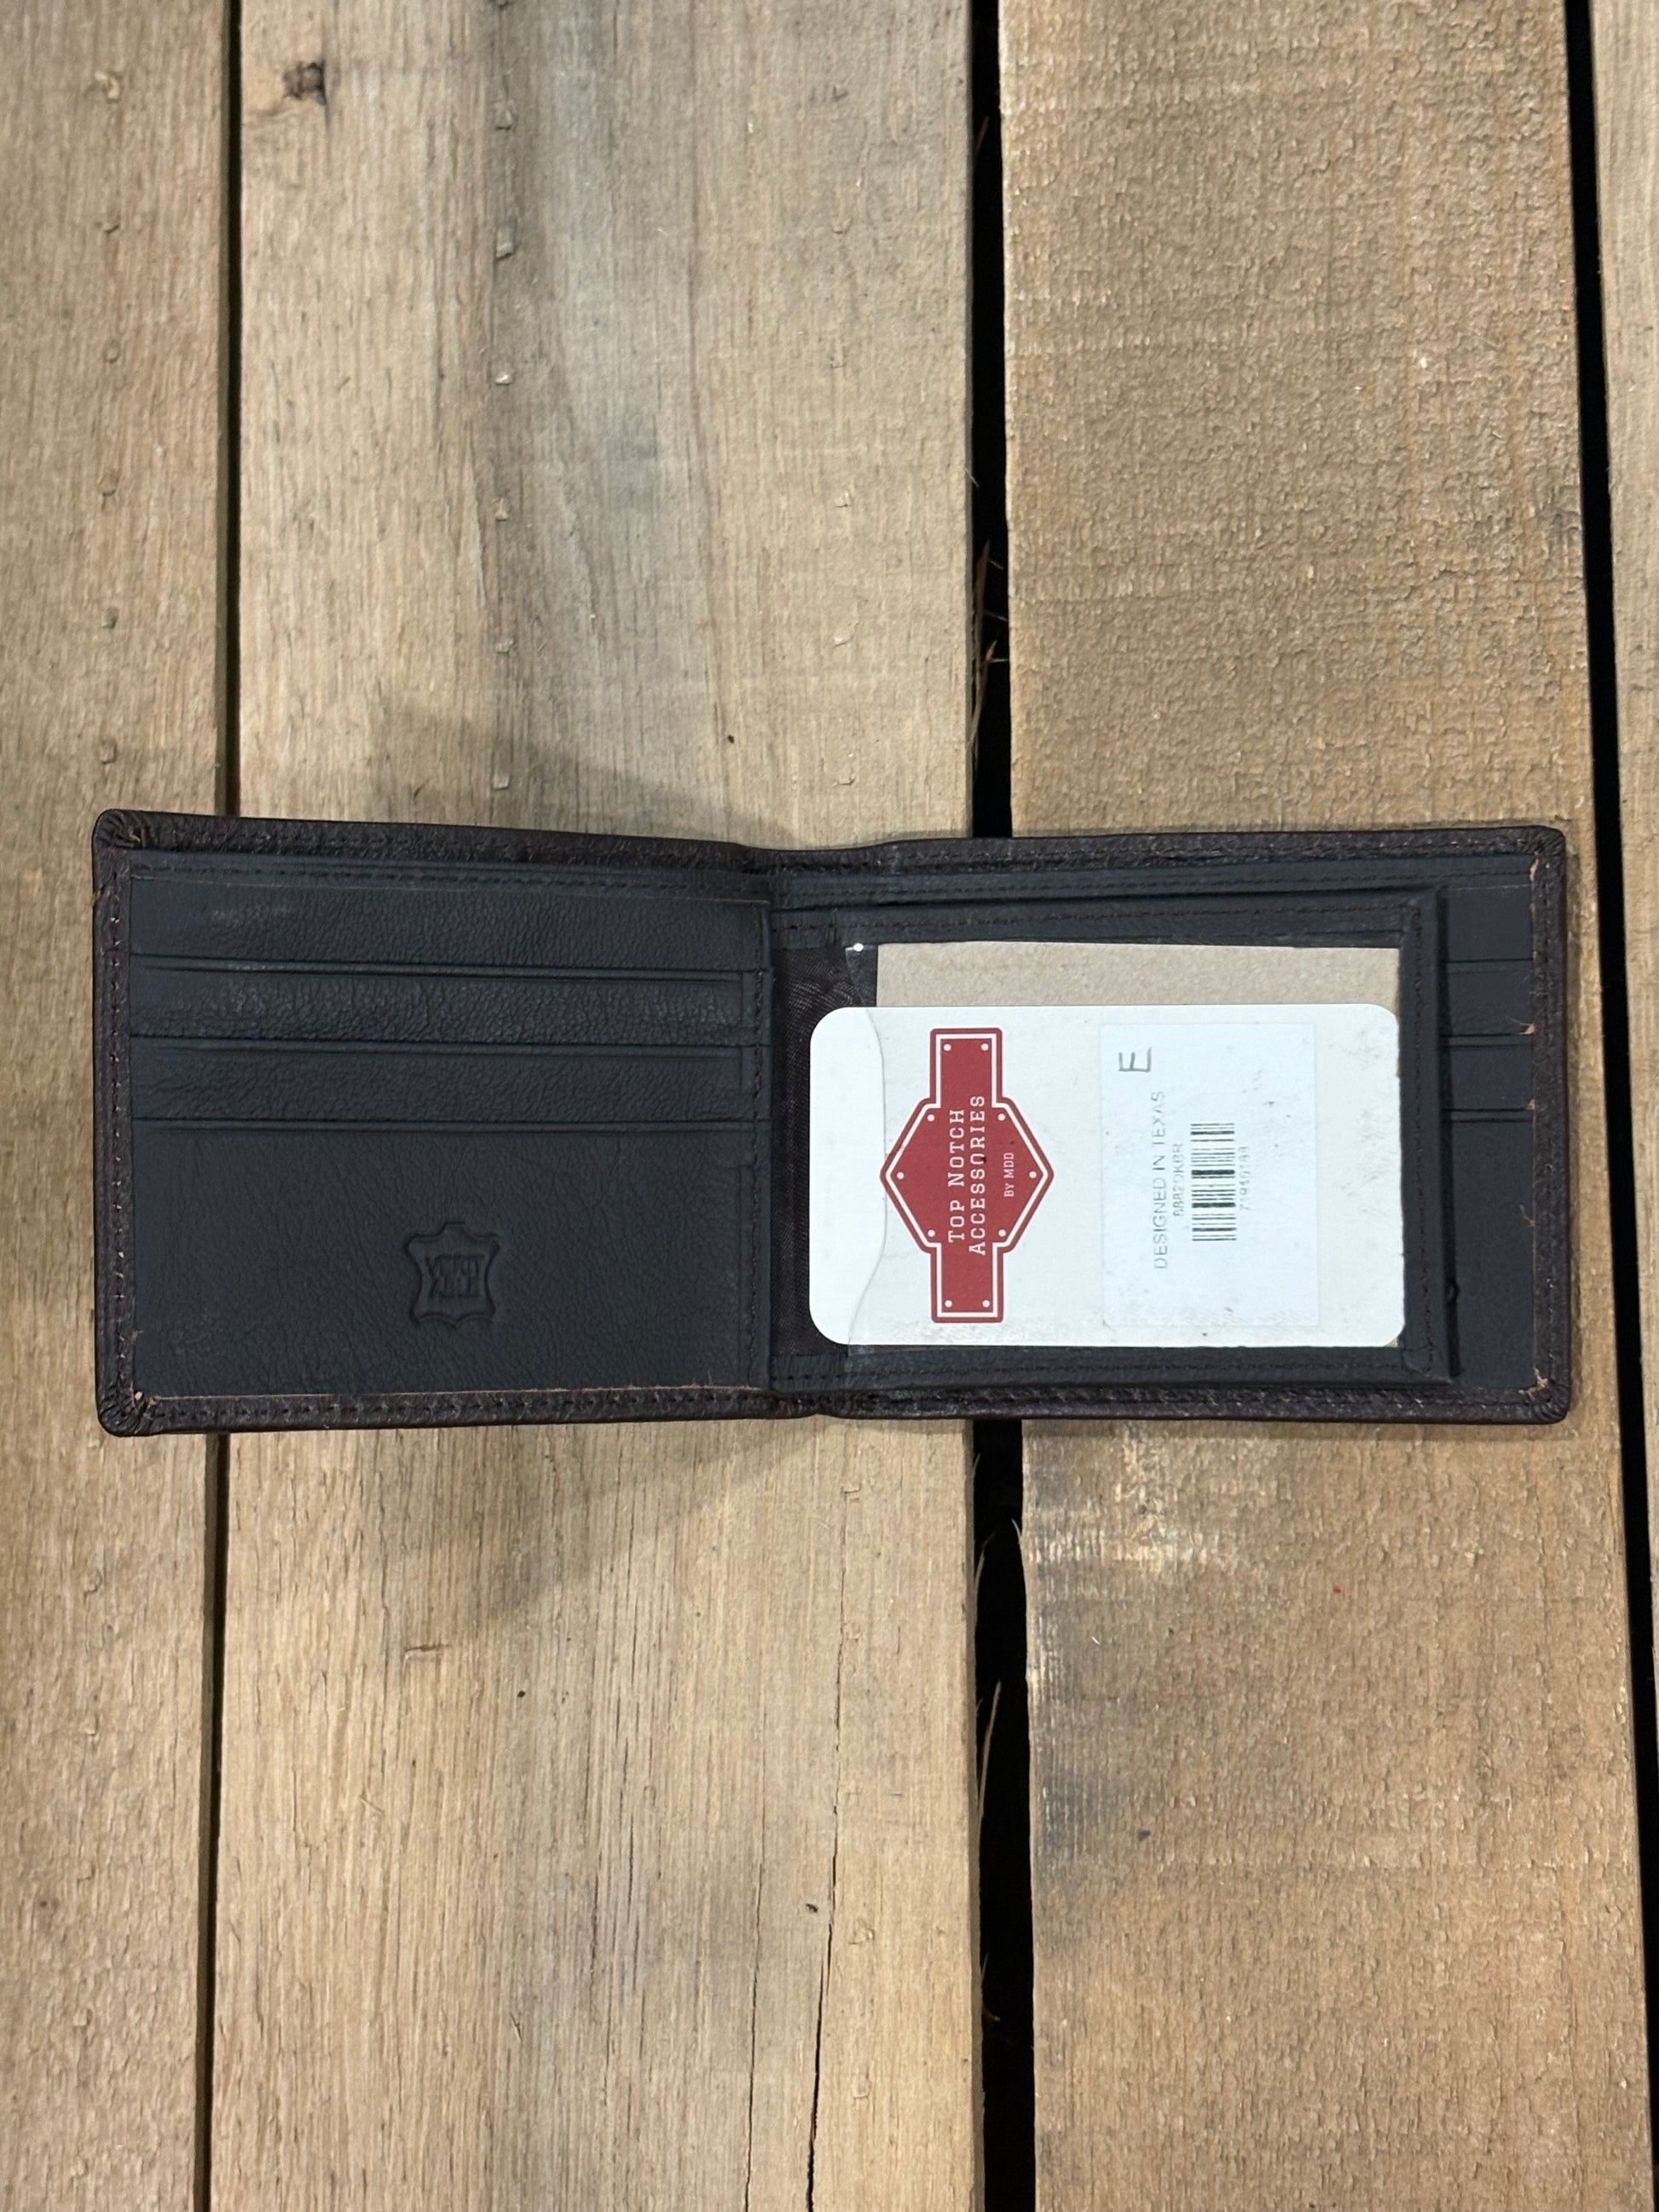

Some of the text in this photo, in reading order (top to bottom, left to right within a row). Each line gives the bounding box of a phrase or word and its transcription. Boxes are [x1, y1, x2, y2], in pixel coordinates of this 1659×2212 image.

[1118, 1047, 1152, 1072] E
[948, 1110, 965, 1243] TOP NOTCH
[968, 1096, 986, 1256] ACCESSORIES
[1003, 1152, 1014, 1197] BY MDD
[1151, 1091, 1168, 1268] DESIGNED IN TEXAS
